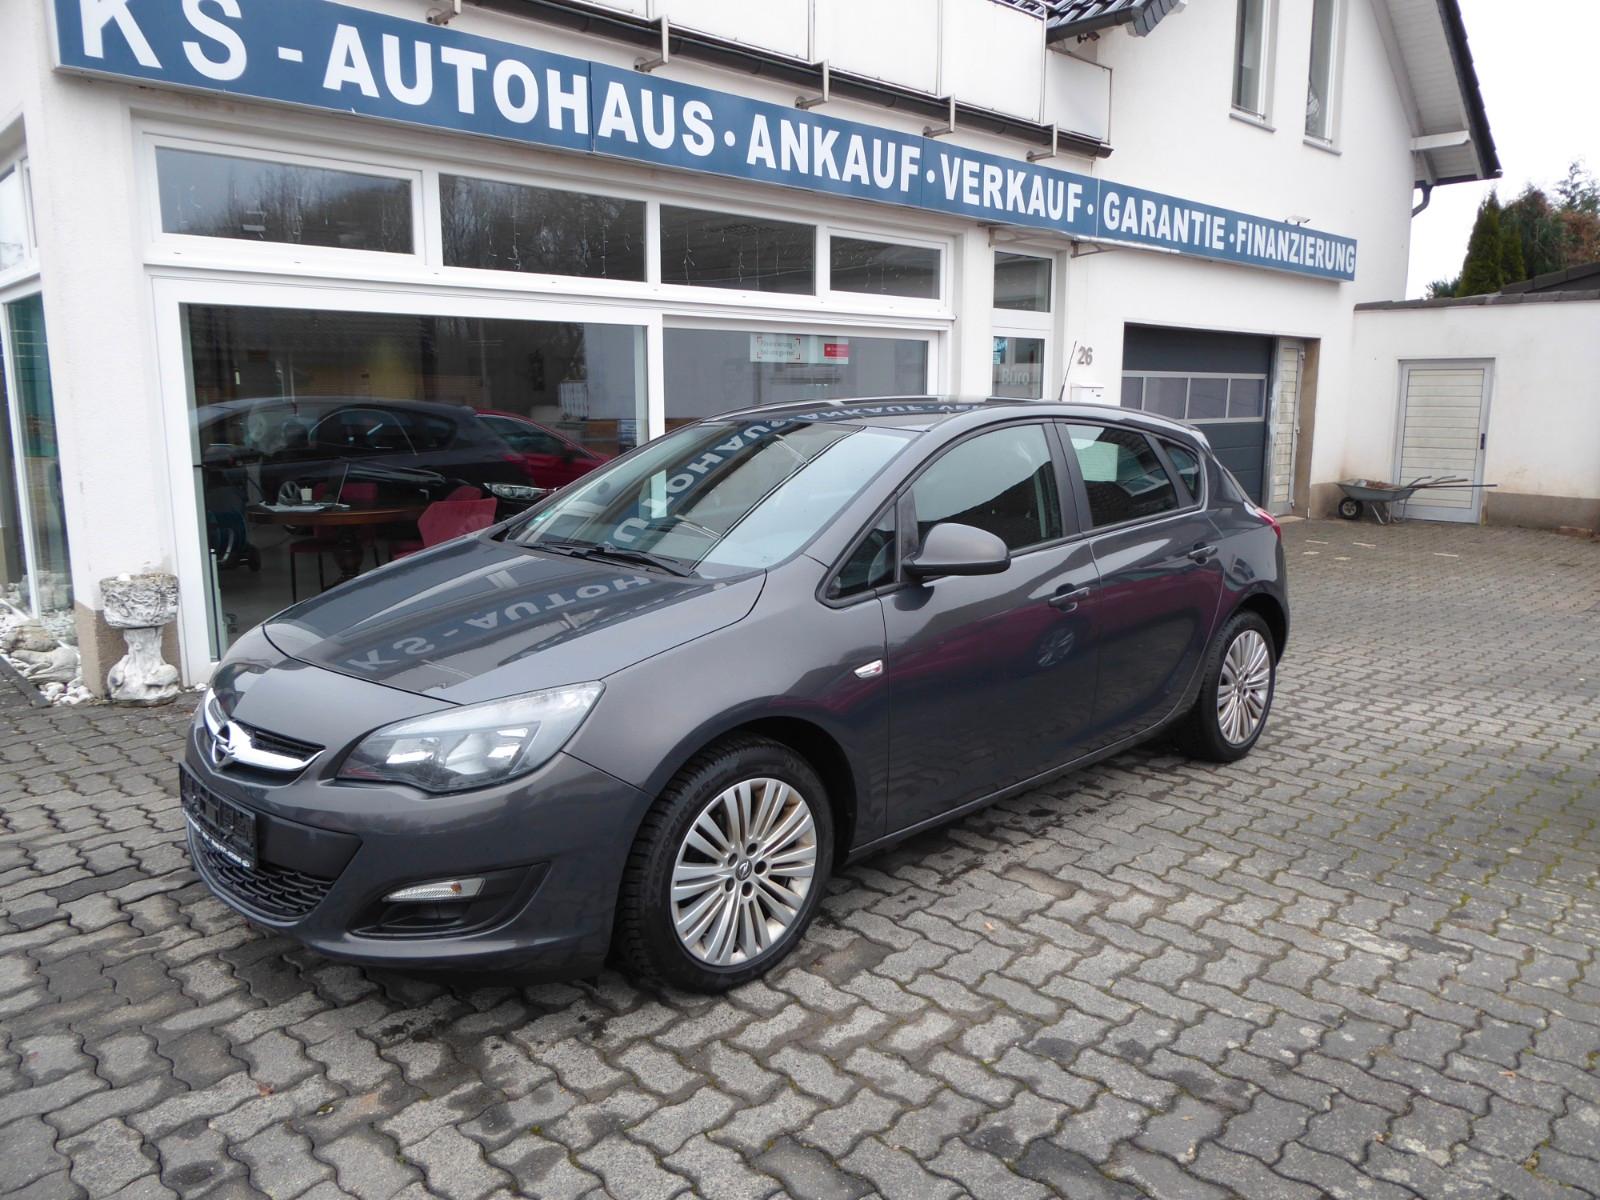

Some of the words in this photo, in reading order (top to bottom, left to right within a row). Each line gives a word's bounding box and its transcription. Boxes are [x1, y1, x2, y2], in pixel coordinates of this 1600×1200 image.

[323, 24, 715, 158] AUTOHAUS
[746, 114, 921, 194] ANKAUF
[940, 153, 1083, 223] VERKAUF
[1103, 191, 1226, 251] GARANTIE
[1235, 221, 1356, 275] FINANZIERUNG
[1077, 345, 1093, 366] 26
[1001, 366, 1030, 385] Büro
